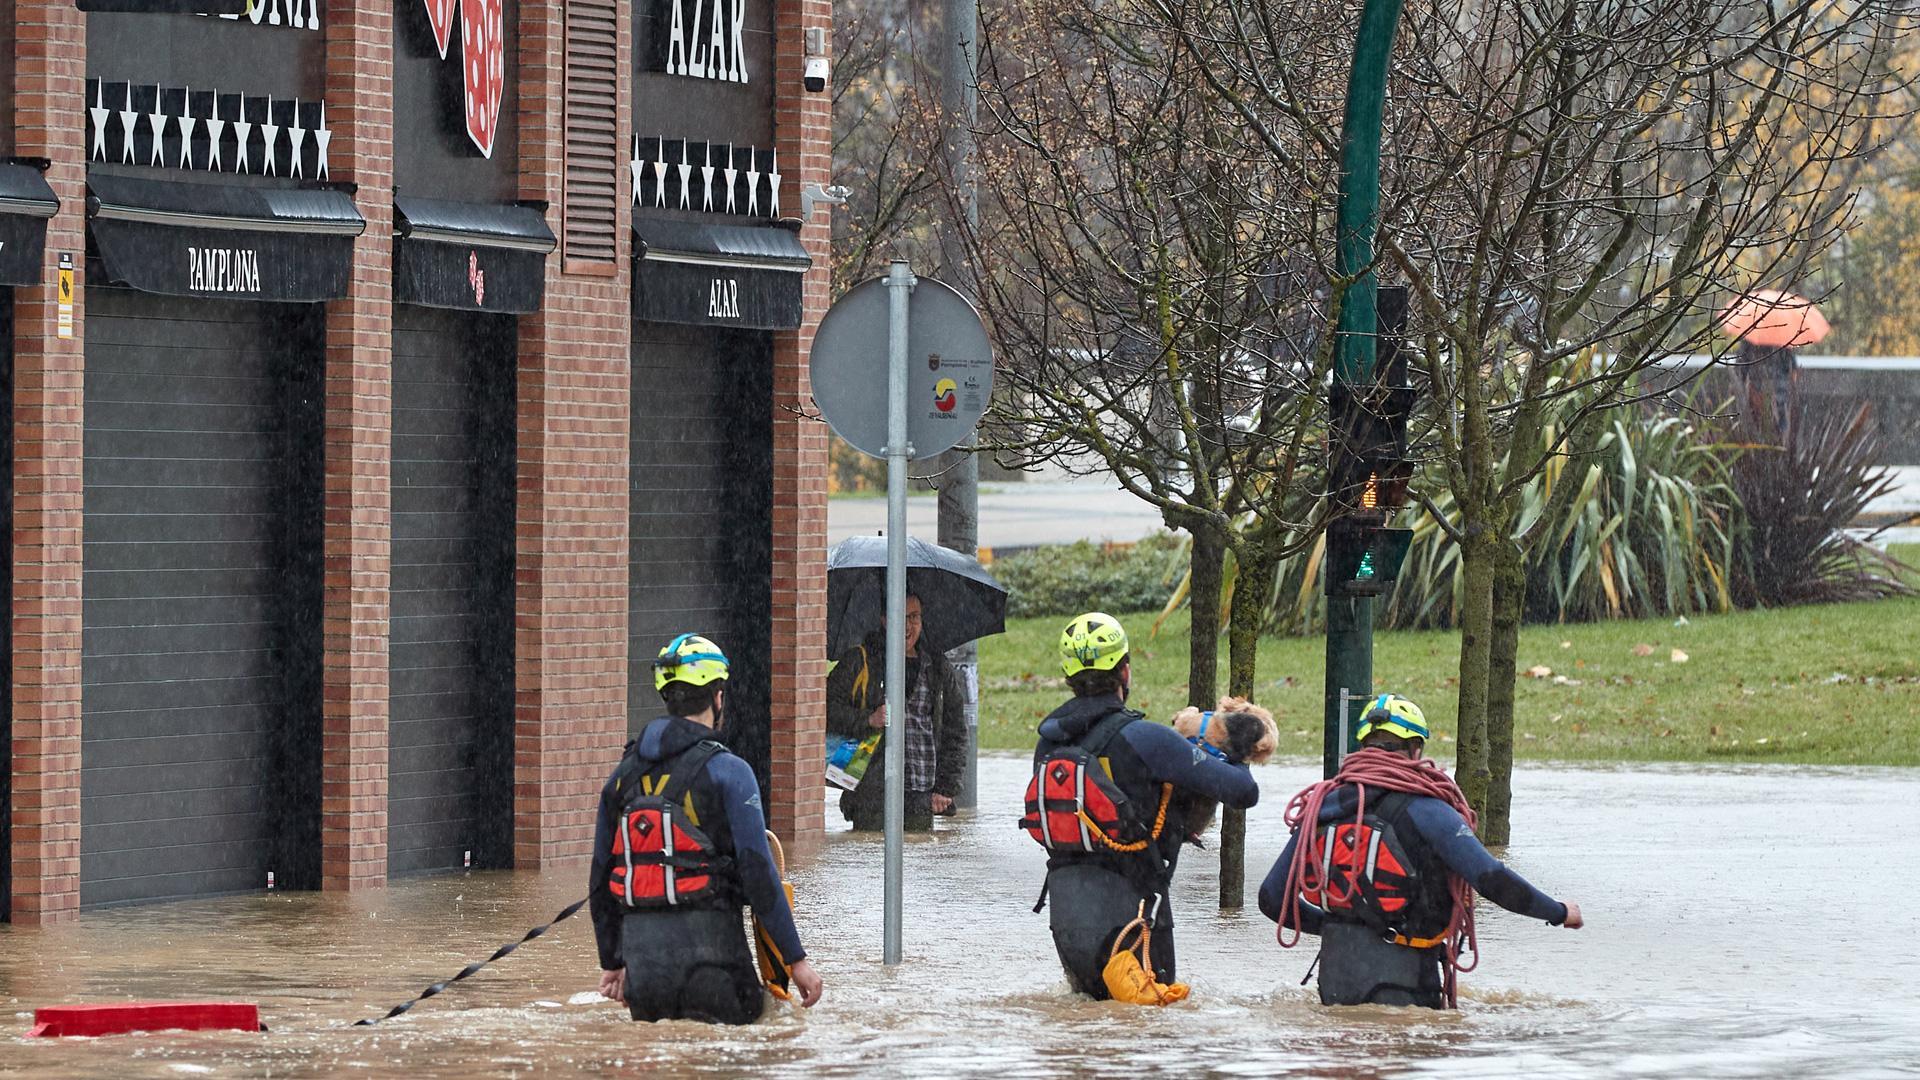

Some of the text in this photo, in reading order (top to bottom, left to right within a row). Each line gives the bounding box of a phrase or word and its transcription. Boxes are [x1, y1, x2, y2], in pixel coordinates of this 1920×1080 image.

[667, 0, 748, 83] AZAR
[188, 247, 261, 292] PAMPLONA
[709, 279, 740, 318] AZAR
